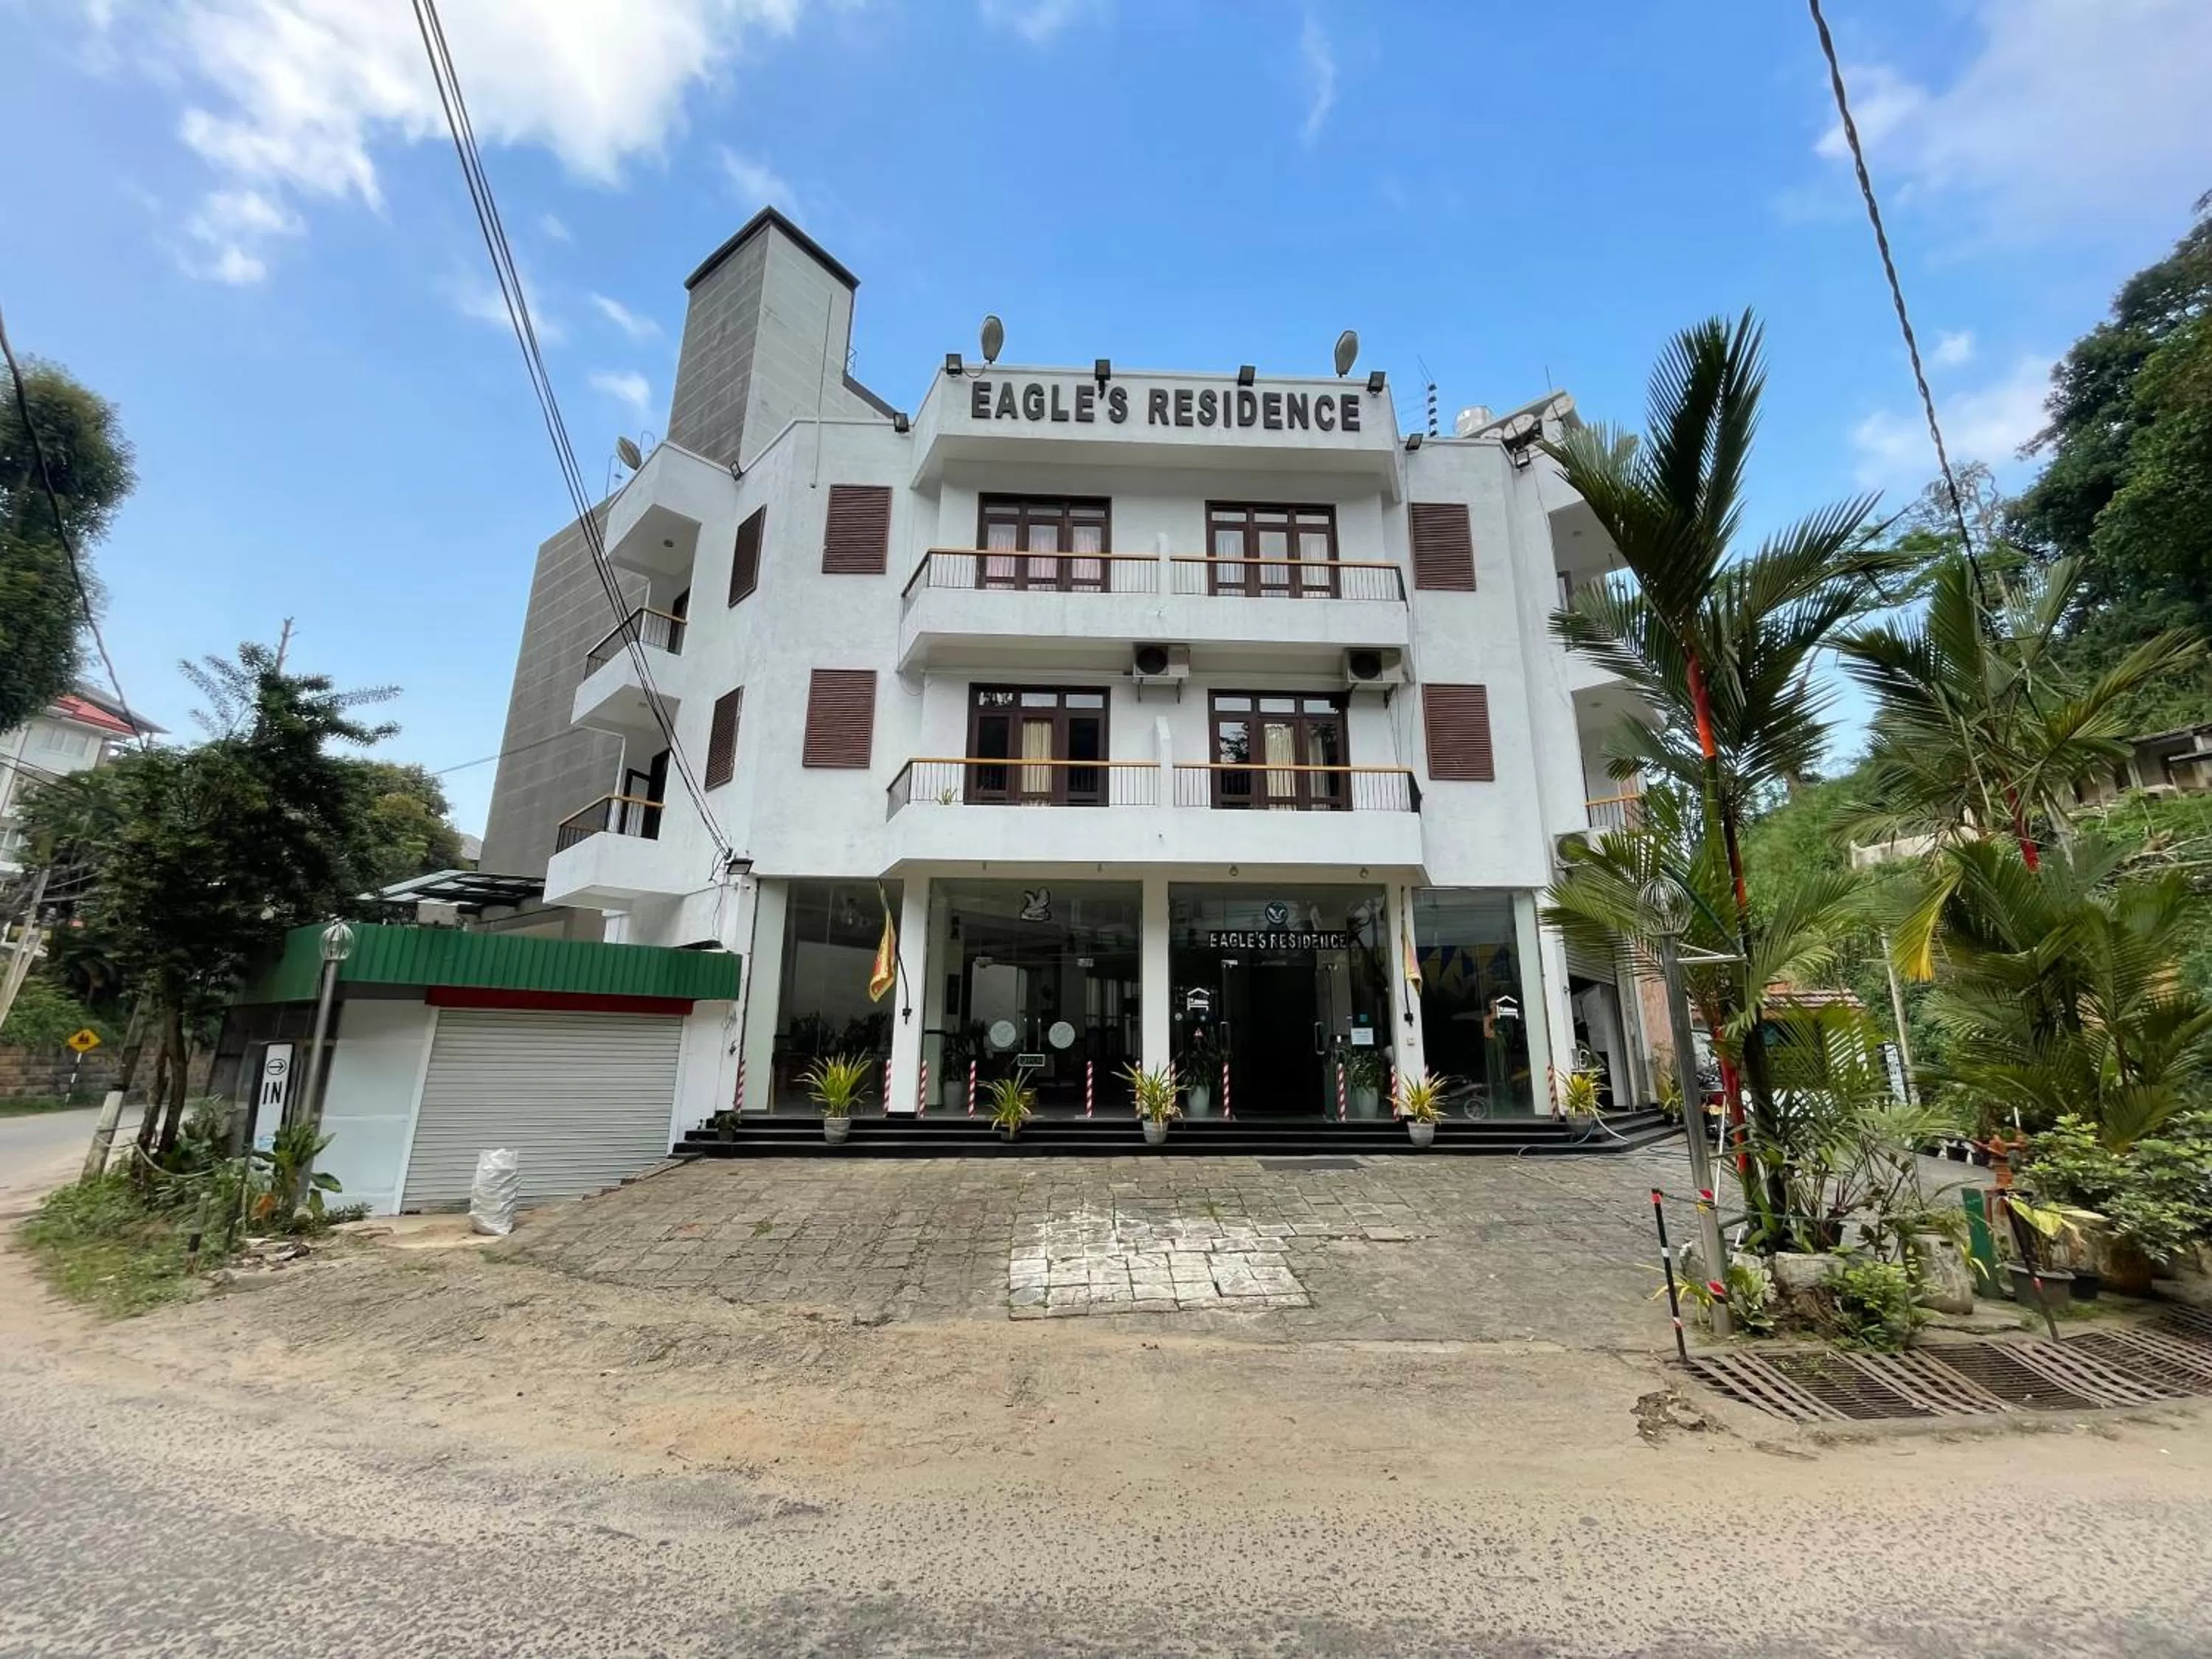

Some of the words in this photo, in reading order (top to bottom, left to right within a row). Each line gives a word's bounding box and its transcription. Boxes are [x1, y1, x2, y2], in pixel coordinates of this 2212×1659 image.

[971, 381, 1128, 424] EAGLE'S
[1148, 389, 1360, 431] RESIDENCE
[1210, 931, 1266, 949] EAGLE'S
[1270, 933, 1347, 949] RESIDENCE
[262, 1080, 282, 1105] IN
